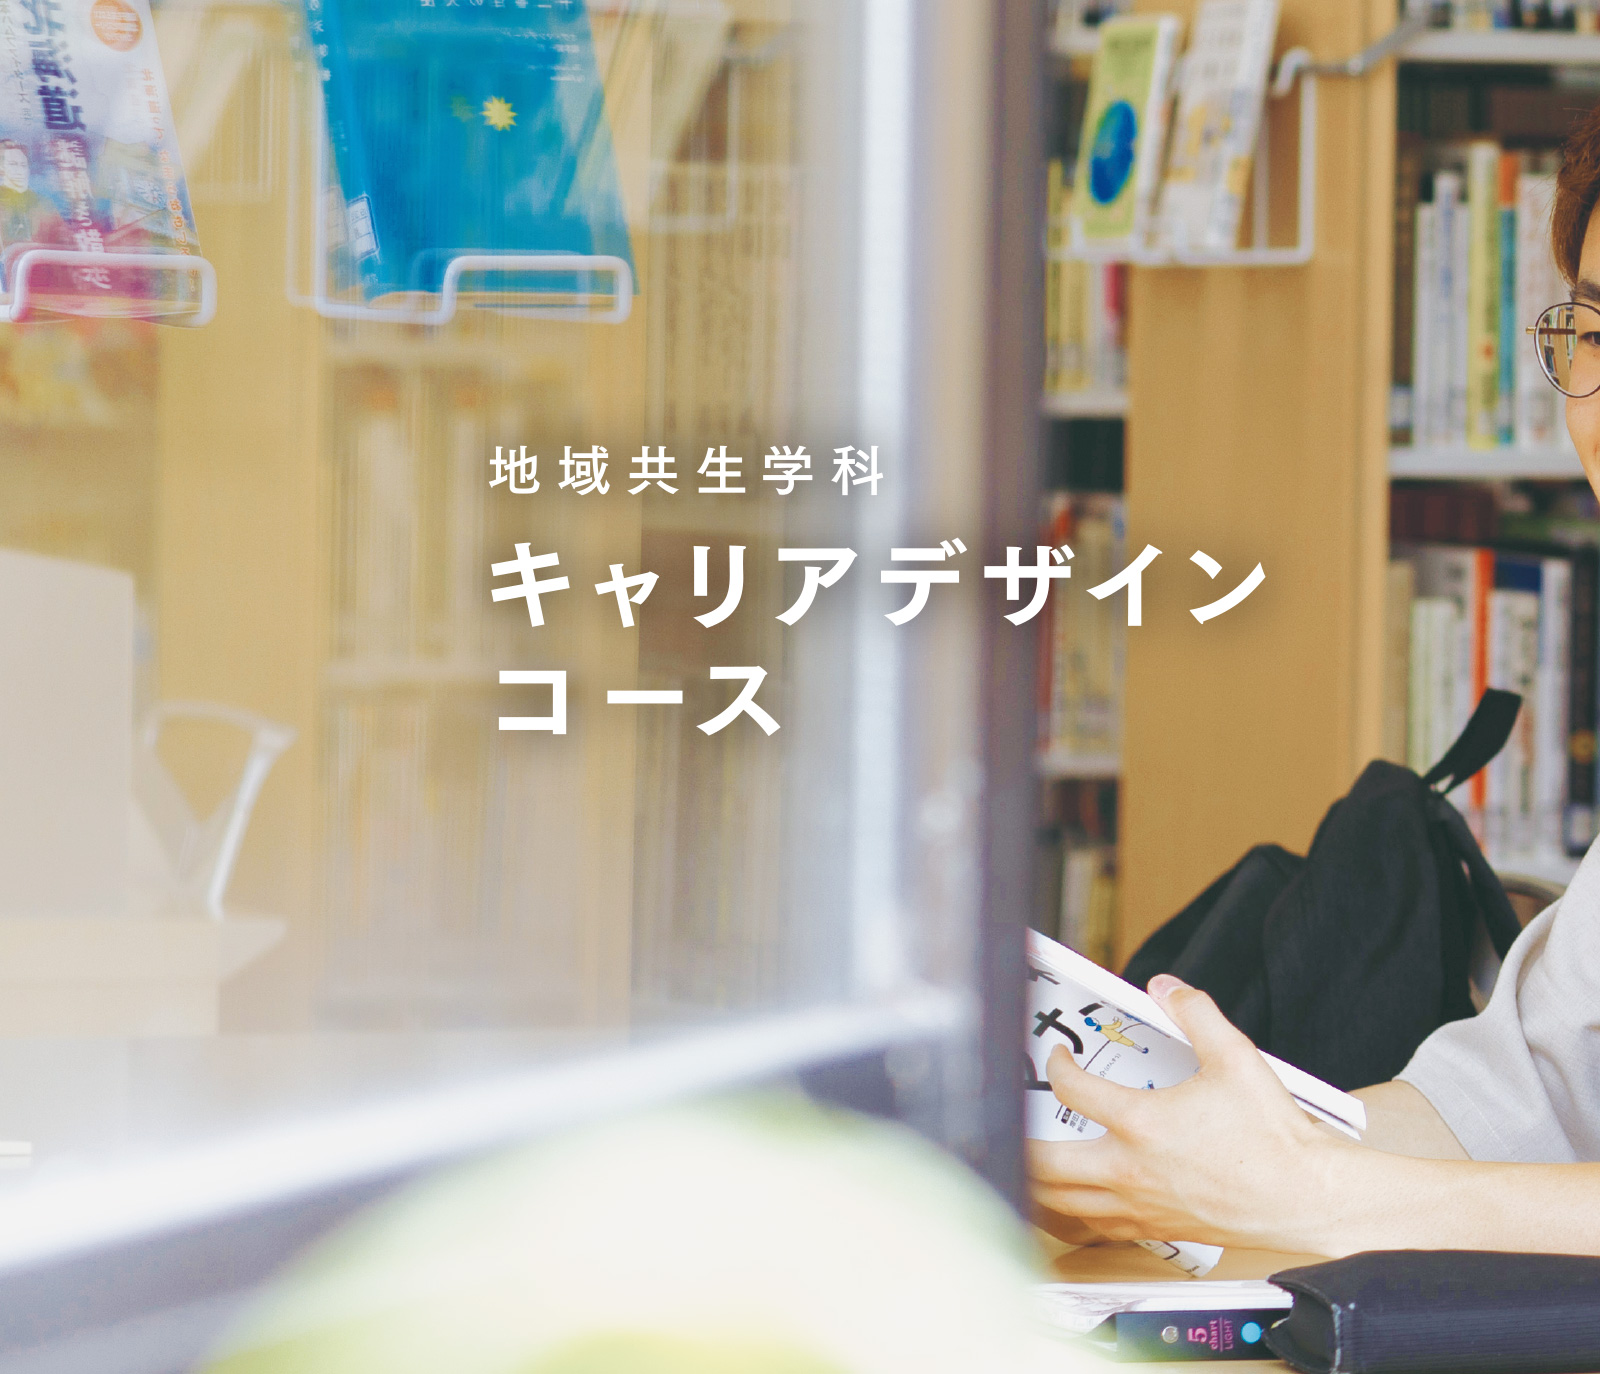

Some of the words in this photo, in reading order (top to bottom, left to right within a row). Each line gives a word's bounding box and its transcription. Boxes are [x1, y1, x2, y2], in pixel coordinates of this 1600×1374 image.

[1187, 1327, 1208, 1343] 5
[1208, 1320, 1218, 1350] chart
[1223, 1320, 1234, 1350] LIGHT
